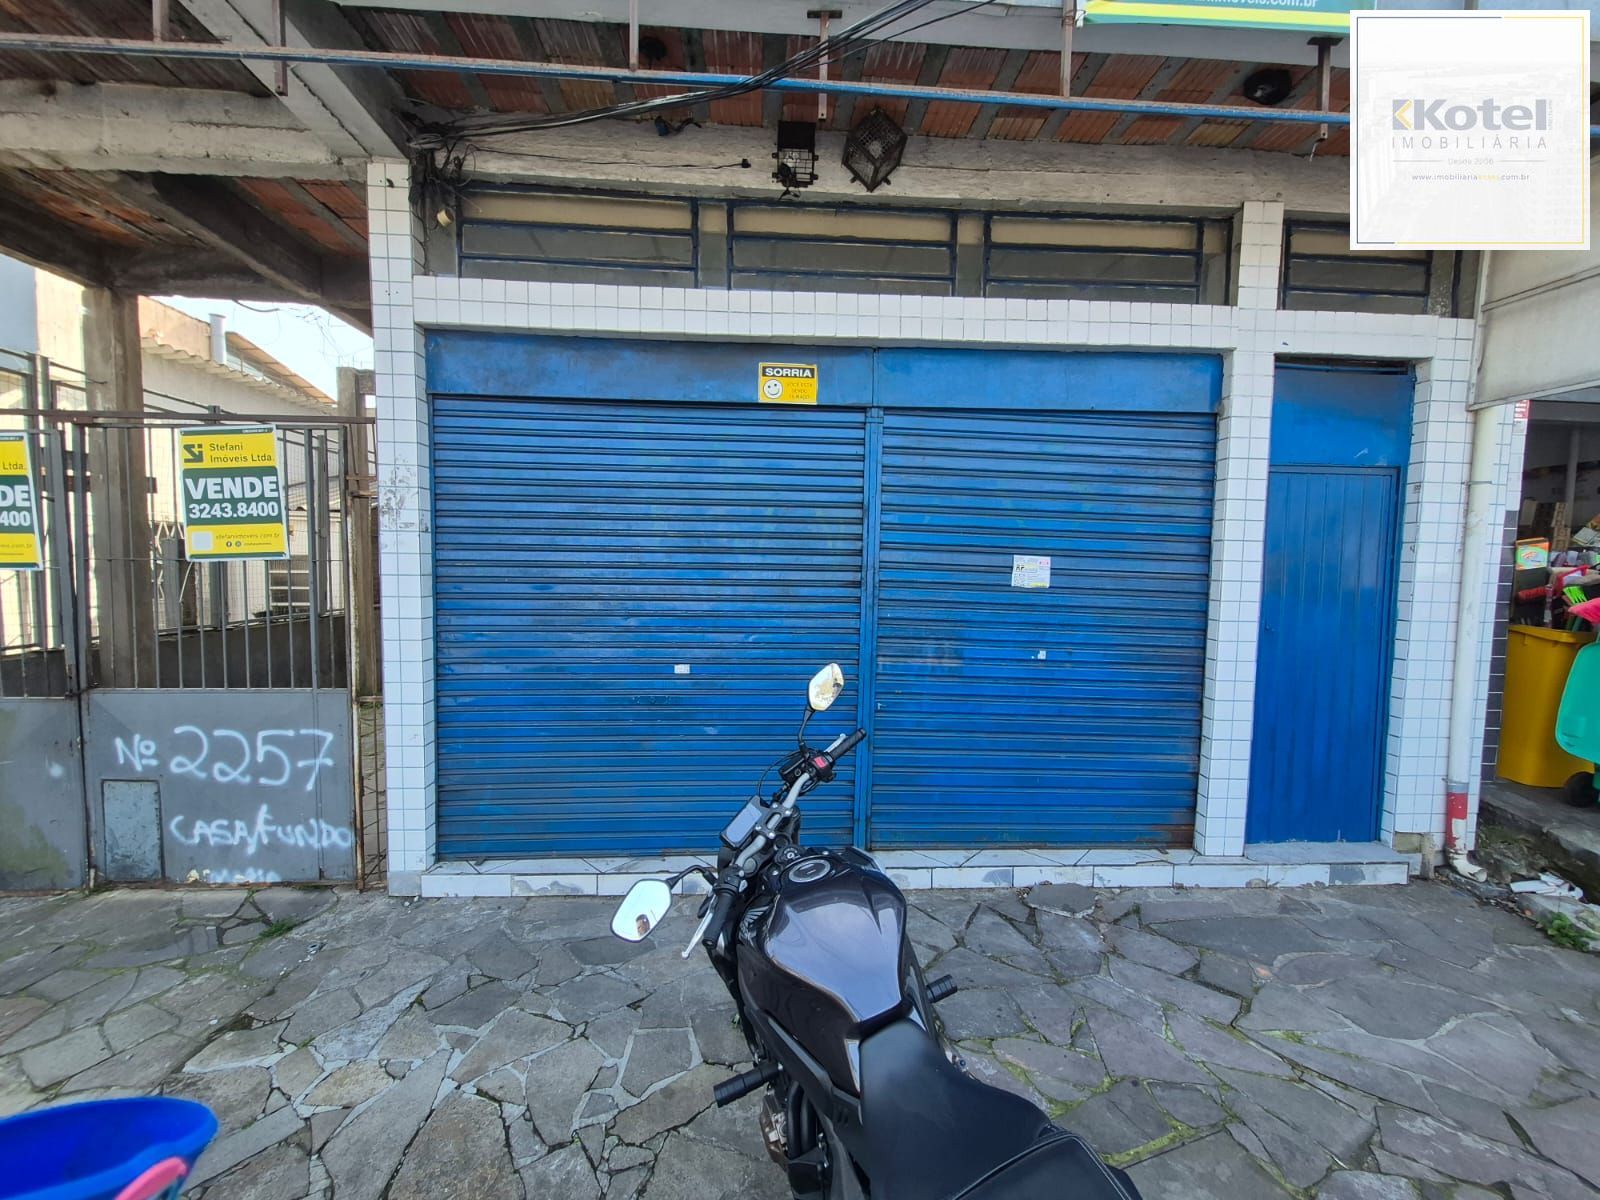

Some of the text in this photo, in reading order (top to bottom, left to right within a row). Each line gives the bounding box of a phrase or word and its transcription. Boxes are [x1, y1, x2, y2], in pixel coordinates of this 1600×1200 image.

[765, 367, 812, 378] SORRIA
[209, 442, 244, 452] Stefani
[251, 453, 272, 462] Ltda
[185, 476, 279, 499] VENDE
[188, 501, 279, 519] 3243.8400
[169, 725, 335, 791] 2257
